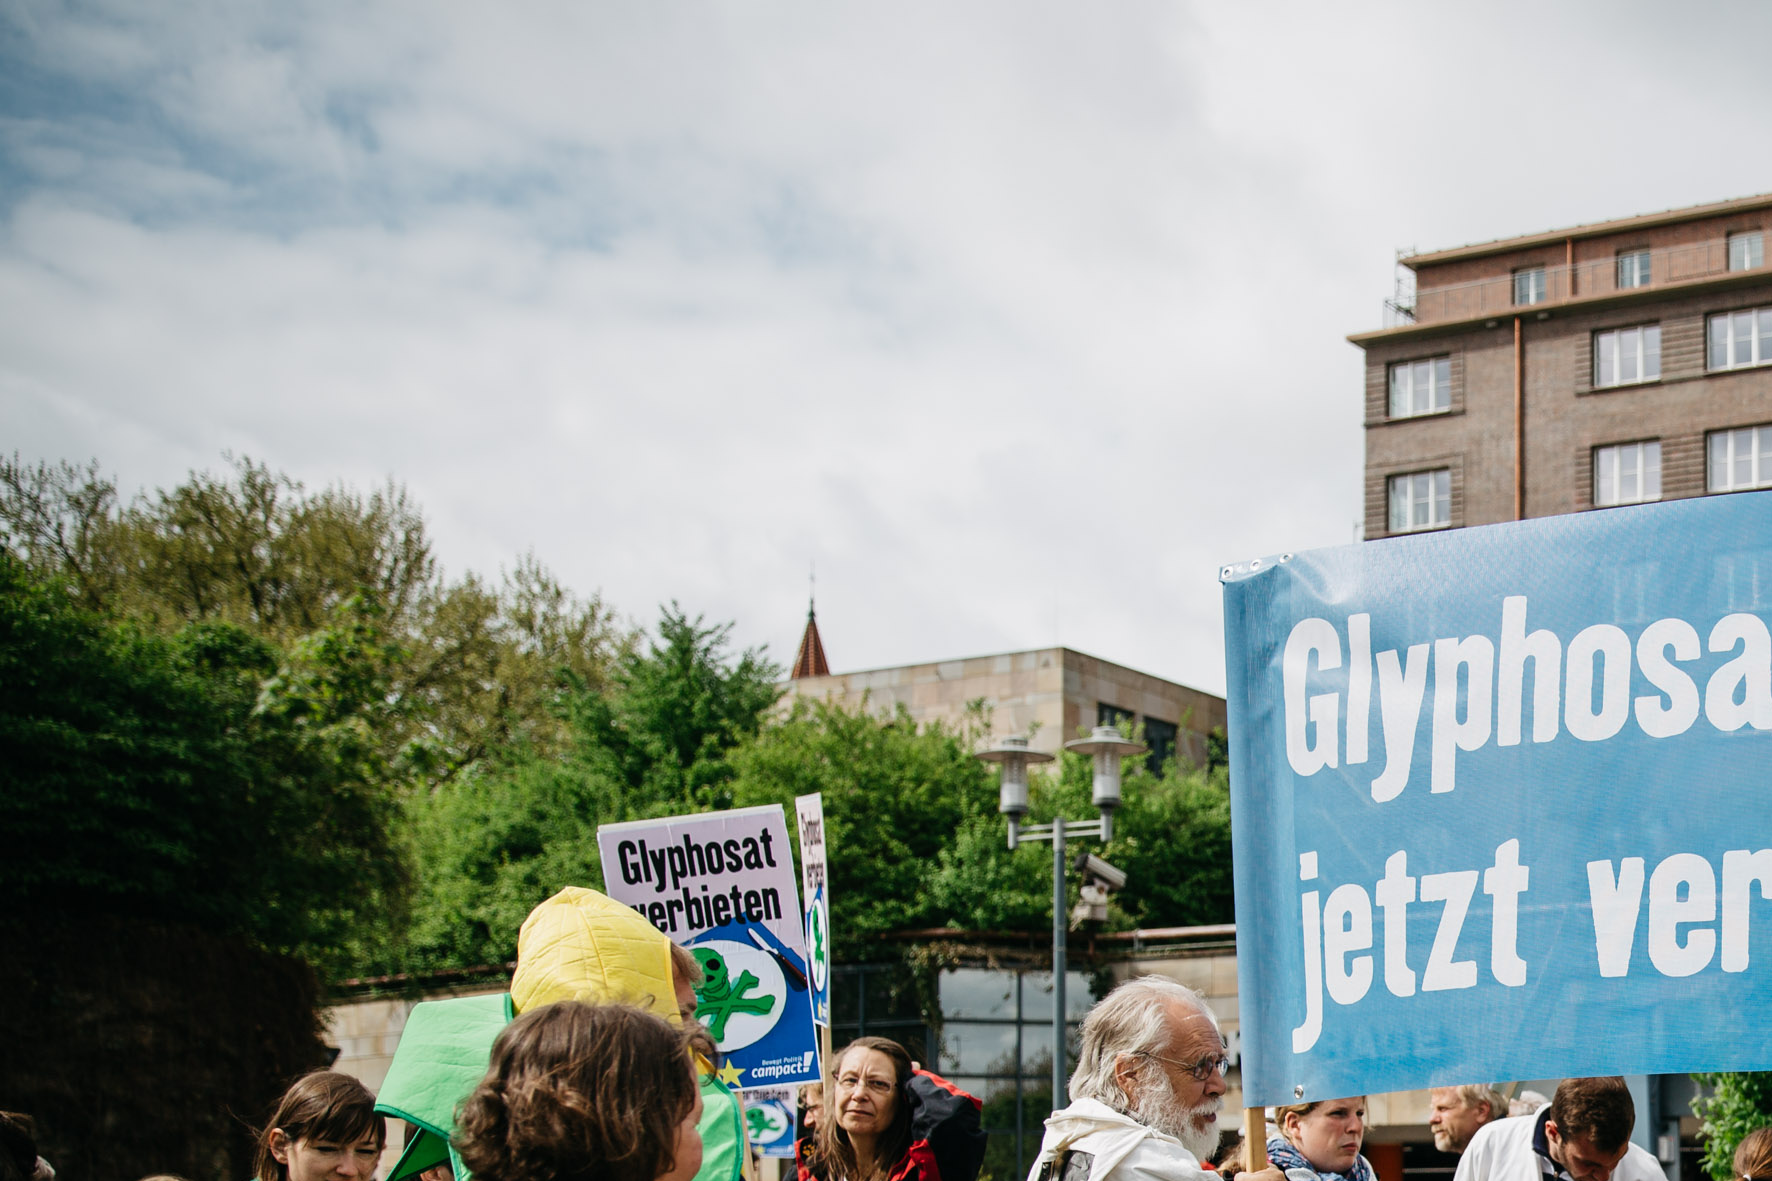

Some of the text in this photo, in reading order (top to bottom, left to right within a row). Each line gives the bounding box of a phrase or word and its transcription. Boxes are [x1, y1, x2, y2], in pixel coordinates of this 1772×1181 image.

[617, 827, 778, 893] Glyphosat
[1292, 837, 1530, 1054] jetzt
[751, 1050, 815, 1079] campact!
